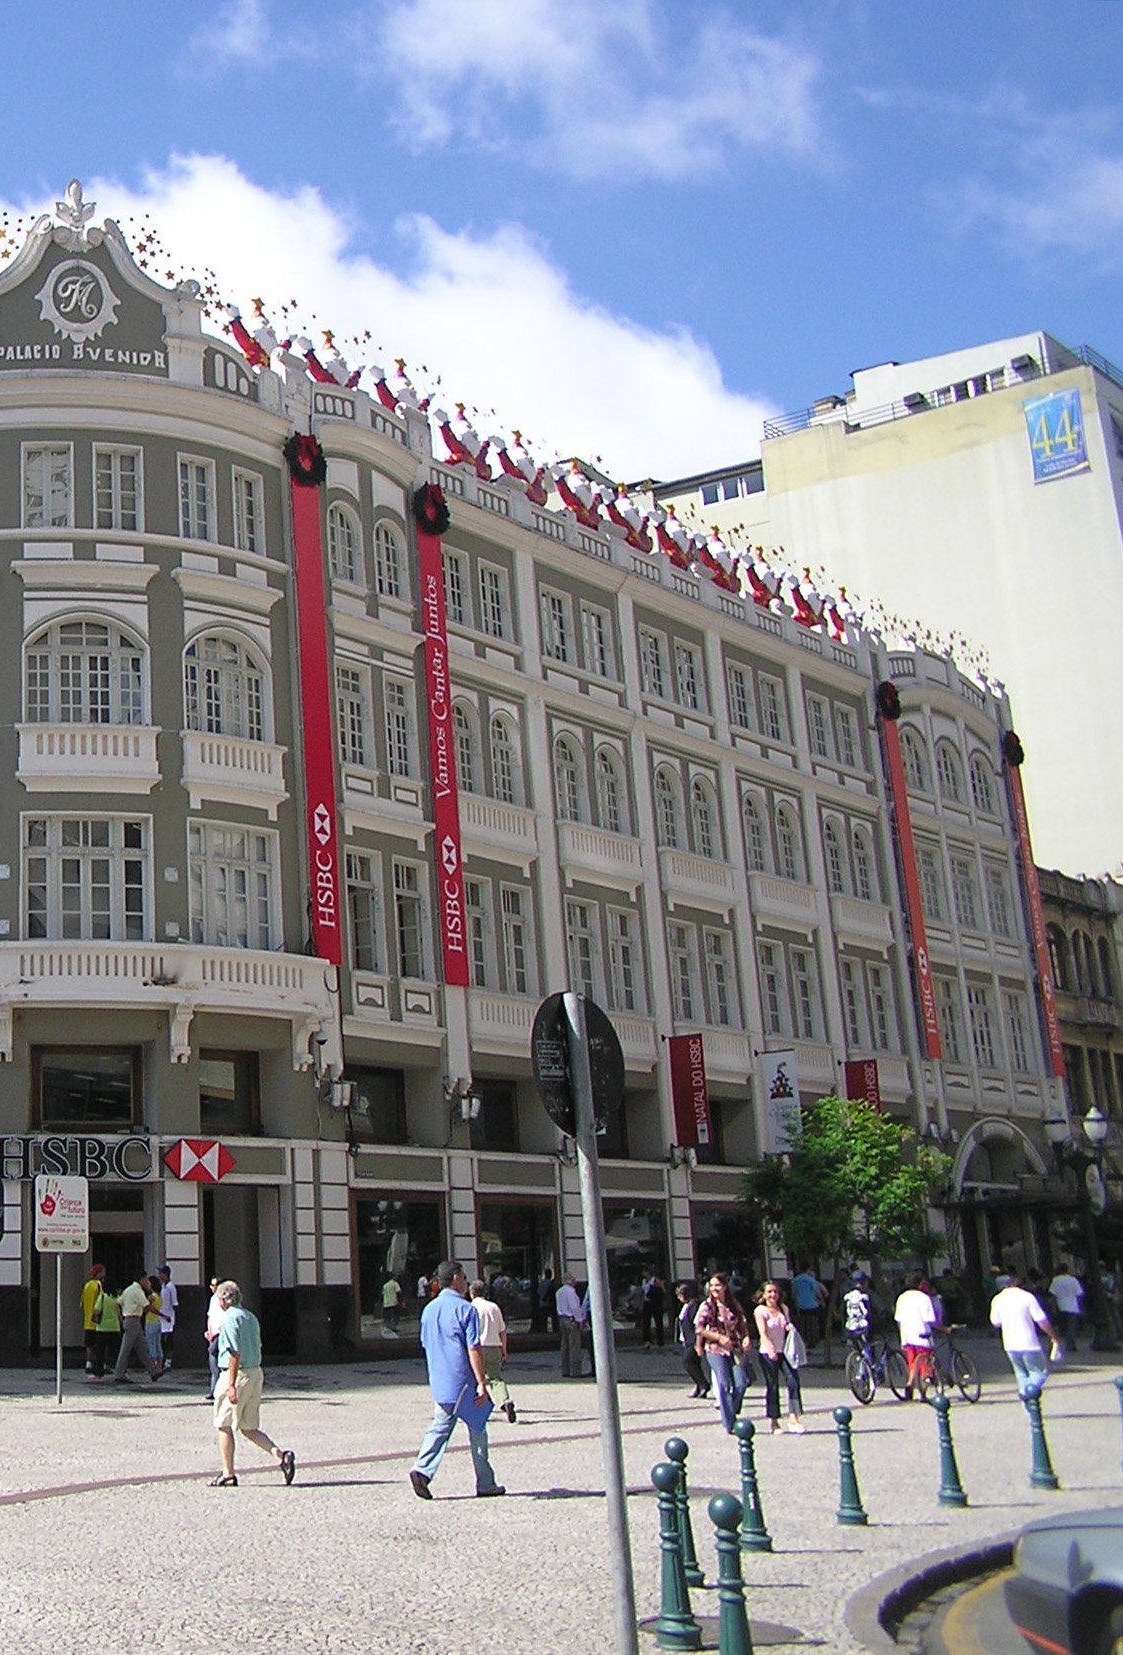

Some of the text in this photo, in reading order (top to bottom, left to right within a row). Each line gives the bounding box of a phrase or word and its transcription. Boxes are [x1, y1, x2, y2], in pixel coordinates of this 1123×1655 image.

[72, 343, 166, 368] AVENIDA
[1032, 408, 1078, 458] 44
[424, 575, 451, 799] Vamos Cantar Juntos
[315, 850, 335, 928] HSBC
[444, 879, 463, 953] HSBC
[921, 979, 937, 1034] HSBC
[689, 1038, 707, 1124] NATAL DO HSBC
[864, 1063, 877, 1089] HSBC
